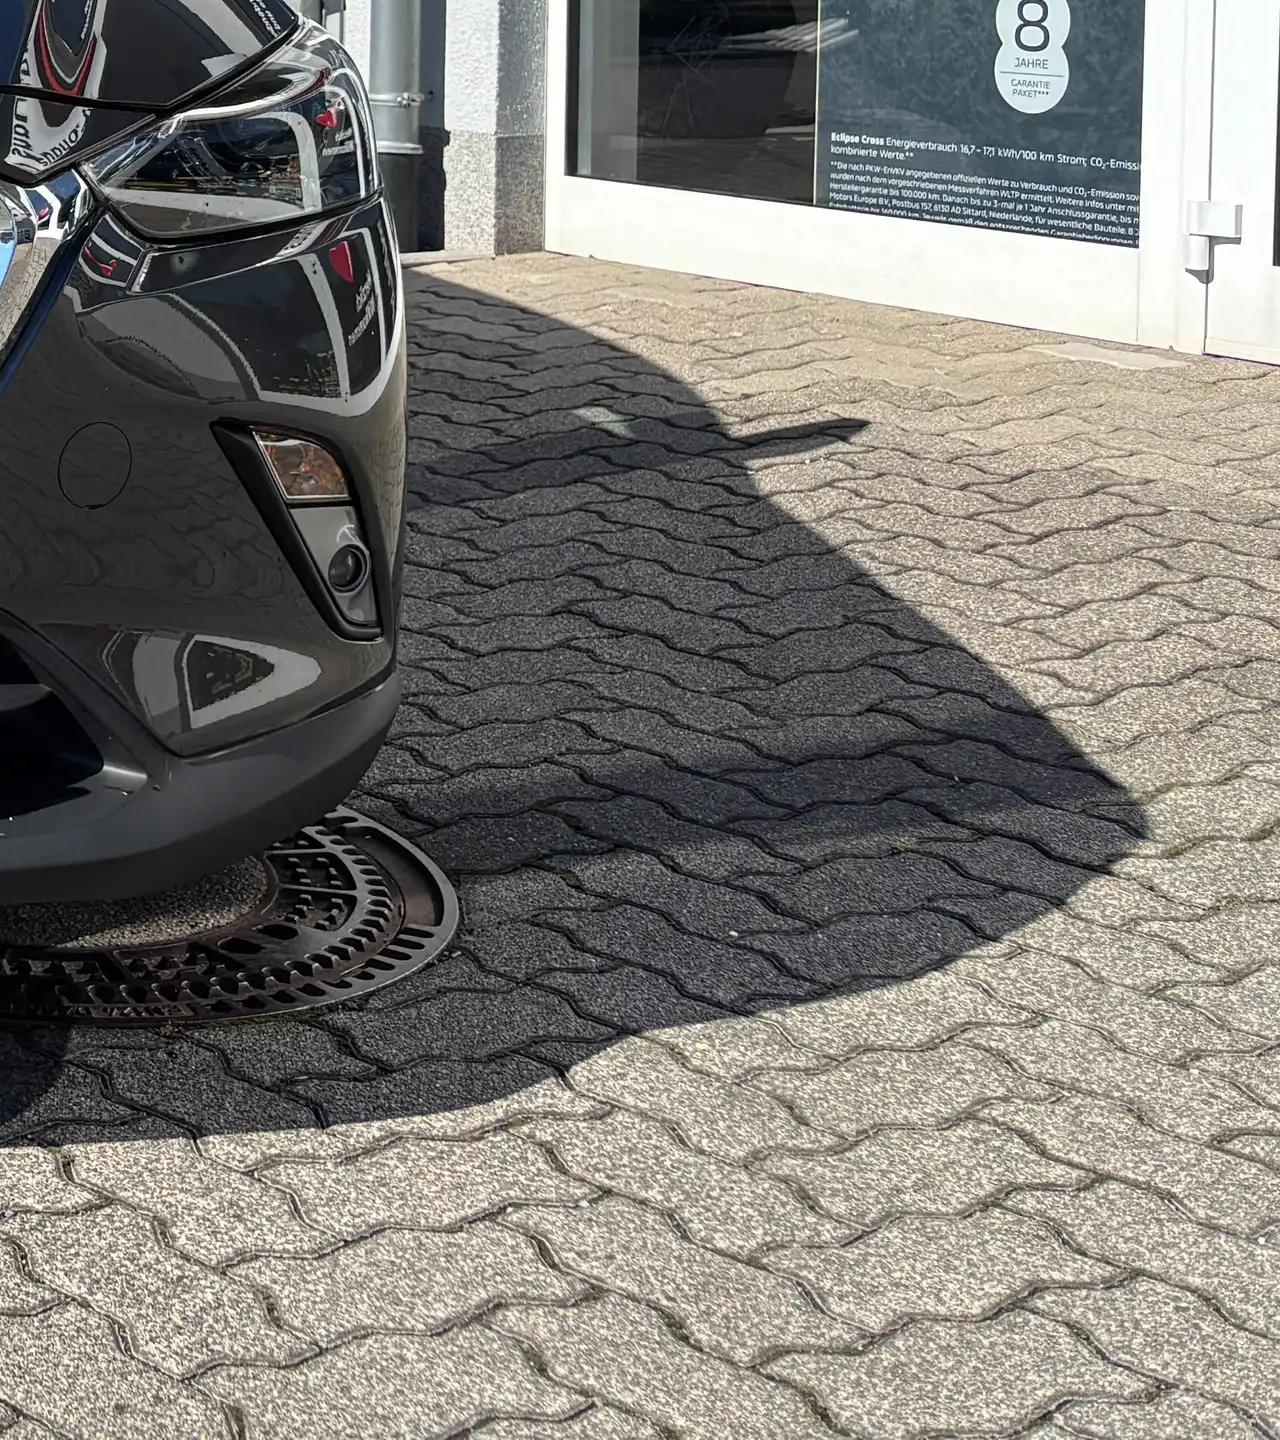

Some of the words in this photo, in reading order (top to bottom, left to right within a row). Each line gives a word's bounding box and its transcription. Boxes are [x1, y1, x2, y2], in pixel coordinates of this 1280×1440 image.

[1014, 57, 1049, 69] JAHRE
[1011, 79, 1050, 90] GARANTIE
[830, 143, 877, 158] kombinierte
[831, 131, 859, 144] Eclipse
[861, 134, 883, 146] Cross
[886, 136, 957, 153] Energieverbrauch
[997, 146, 1036, 161] kWh/100
[1039, 151, 1054, 162] km
[1057, 153, 1087, 167] Strom;
[1020, 180, 1057, 192] Verbrauch
[1058, 184, 1072, 194] und
